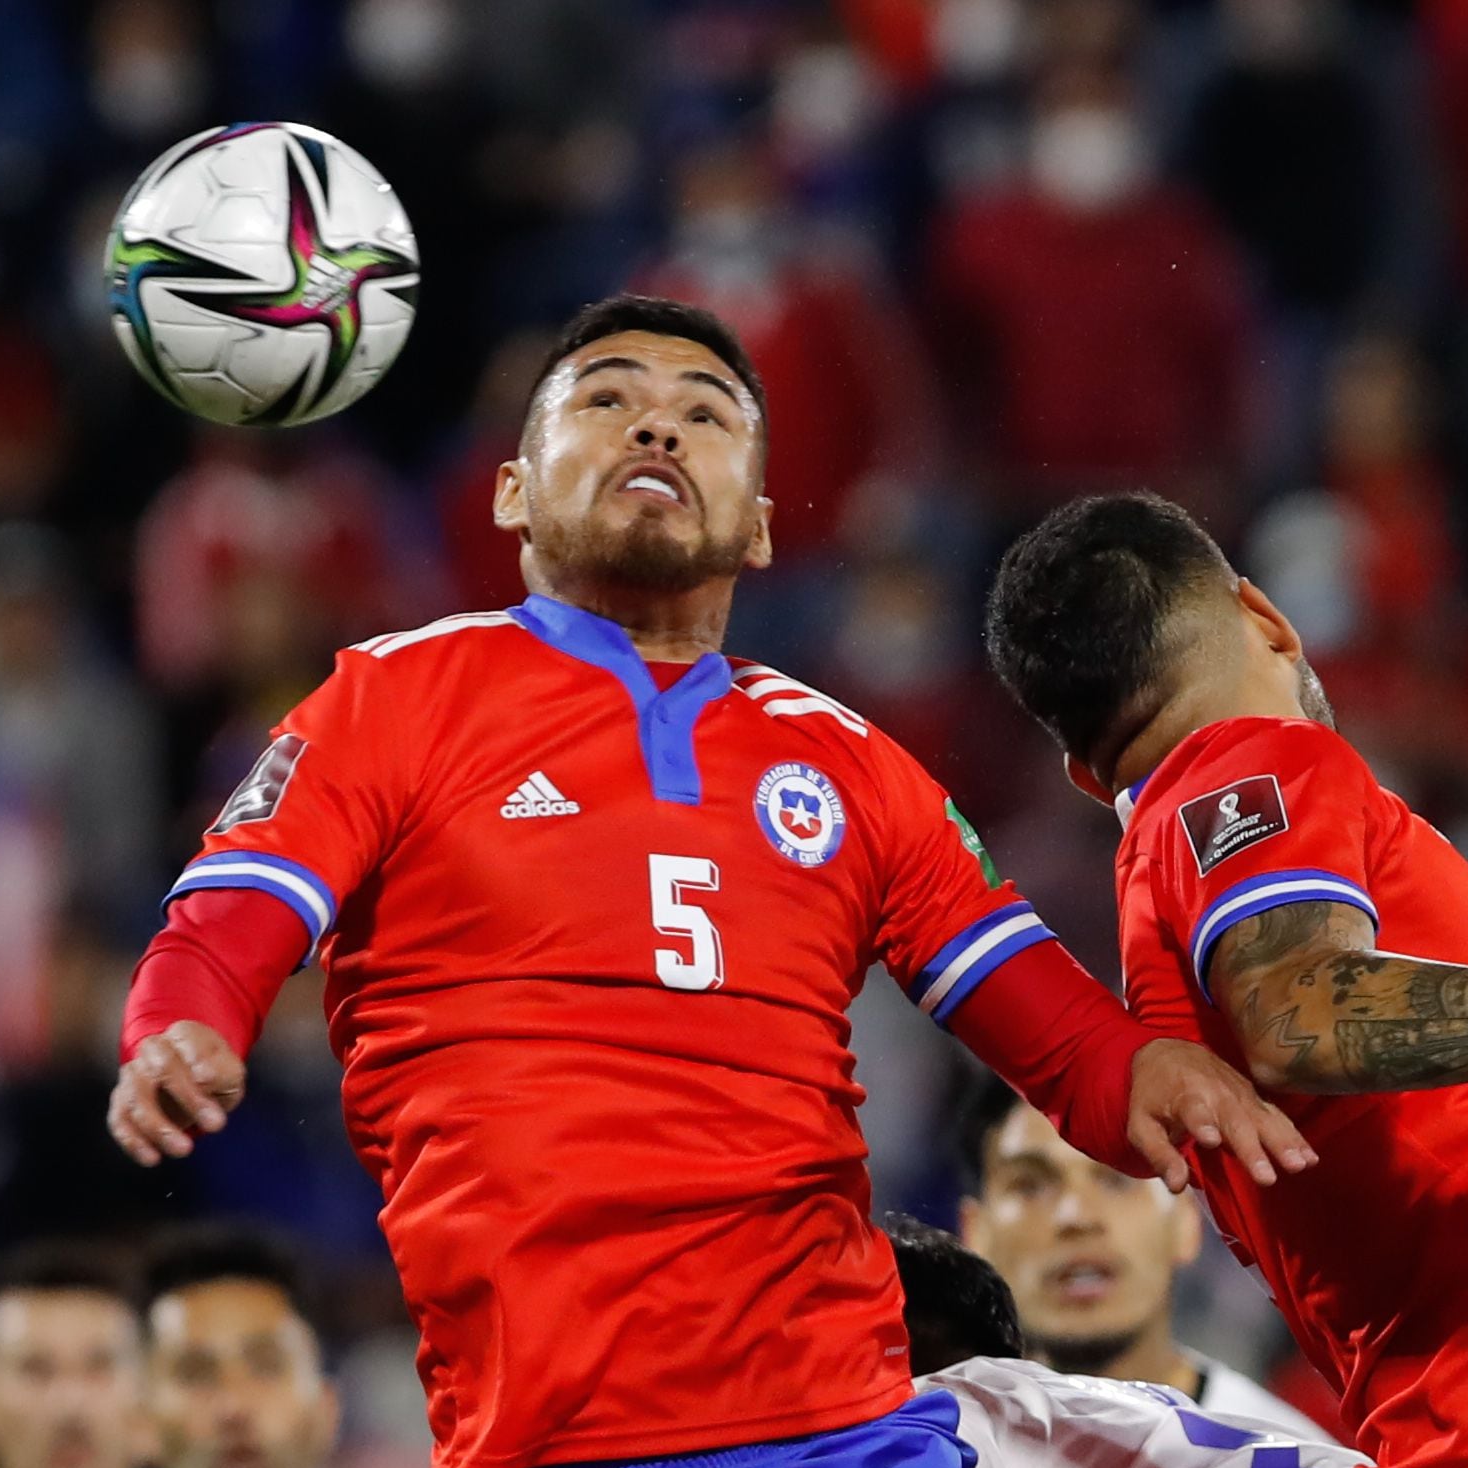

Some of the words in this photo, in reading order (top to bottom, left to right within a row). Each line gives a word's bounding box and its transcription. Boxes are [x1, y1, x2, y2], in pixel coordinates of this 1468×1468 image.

[500, 800, 580, 819] adidas
[1213, 825, 1268, 858] Qualifiers
[649, 853, 724, 990] 5
